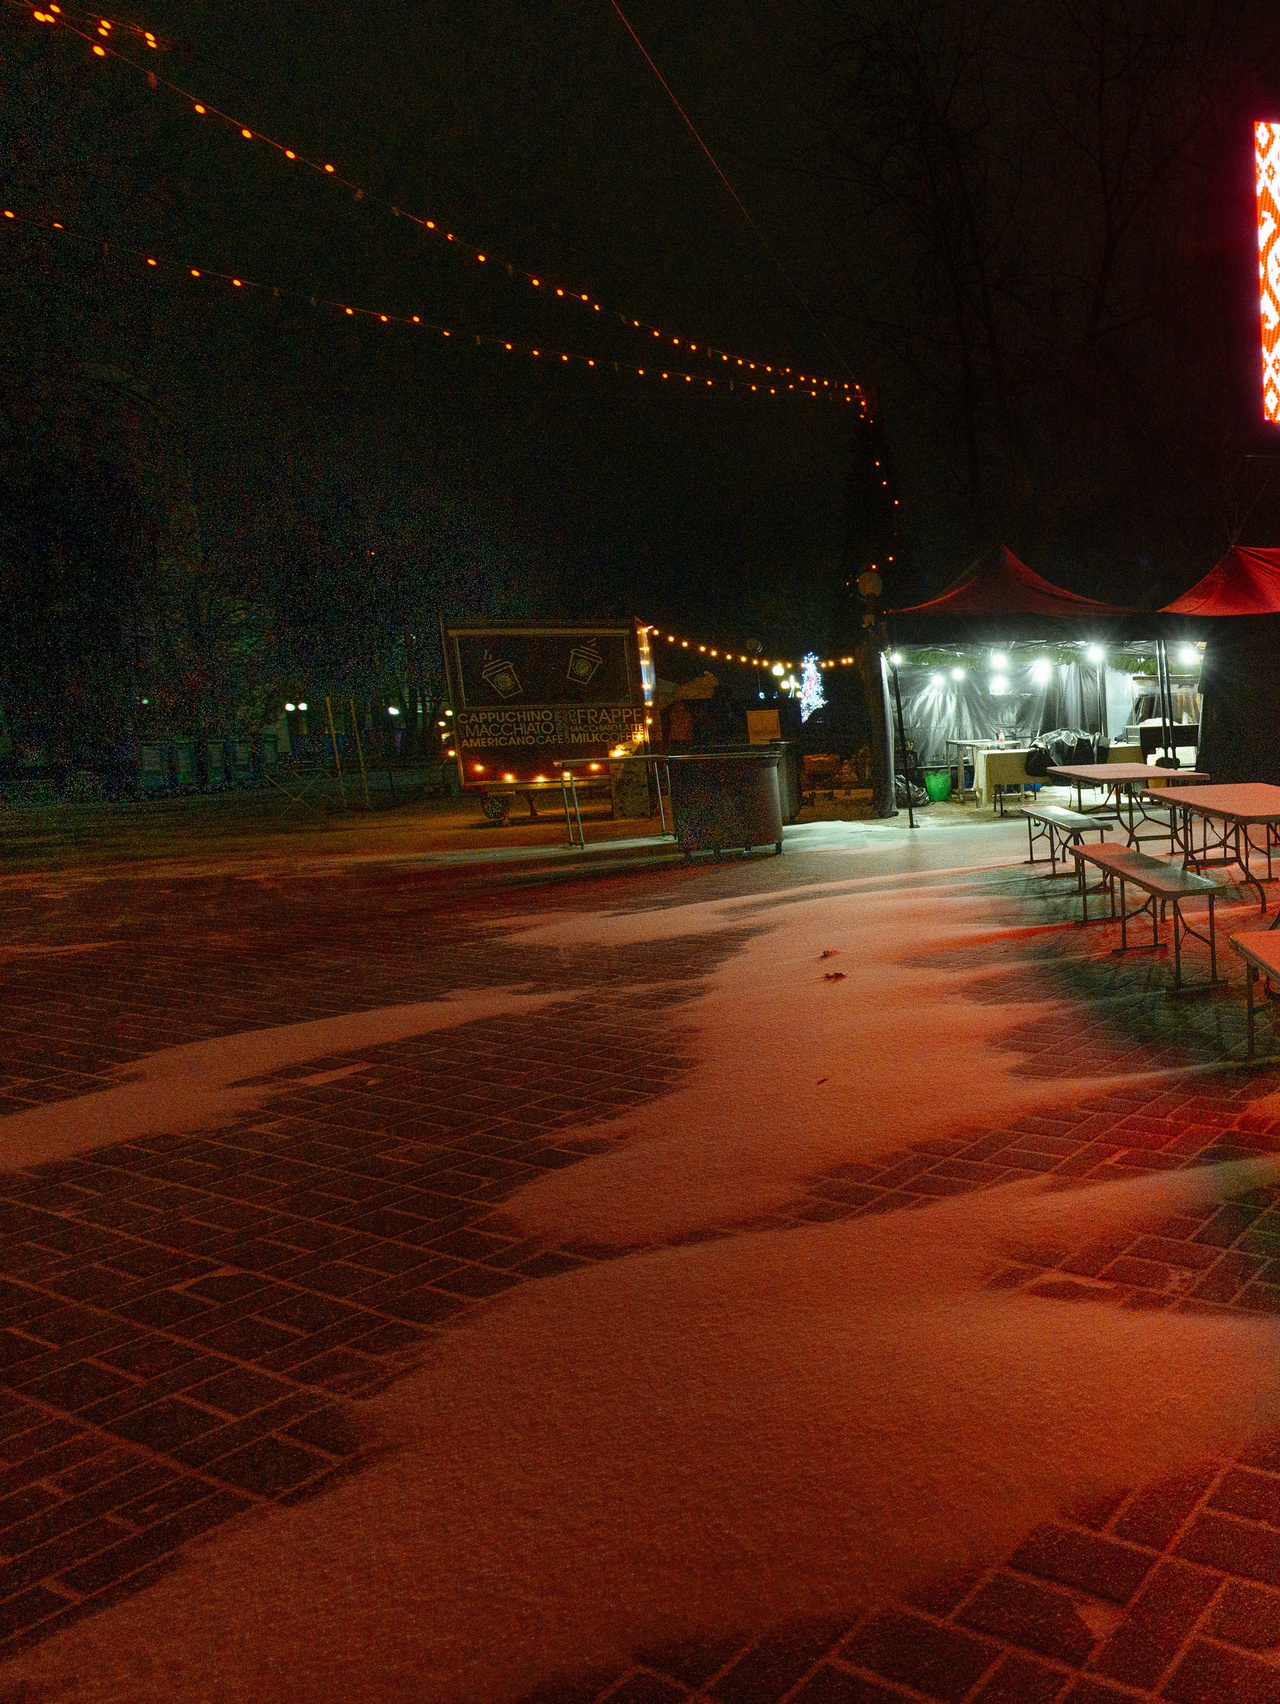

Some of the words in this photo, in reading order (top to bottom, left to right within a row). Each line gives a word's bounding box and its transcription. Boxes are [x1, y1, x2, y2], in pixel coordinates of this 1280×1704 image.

[457, 709, 553, 724] CAPPUCHINO
[465, 721, 554, 737] MACCHIATO
[461, 735, 535, 748] AMERICANO
[536, 734, 564, 745] CAFE
[571, 732, 600, 743] MILK
